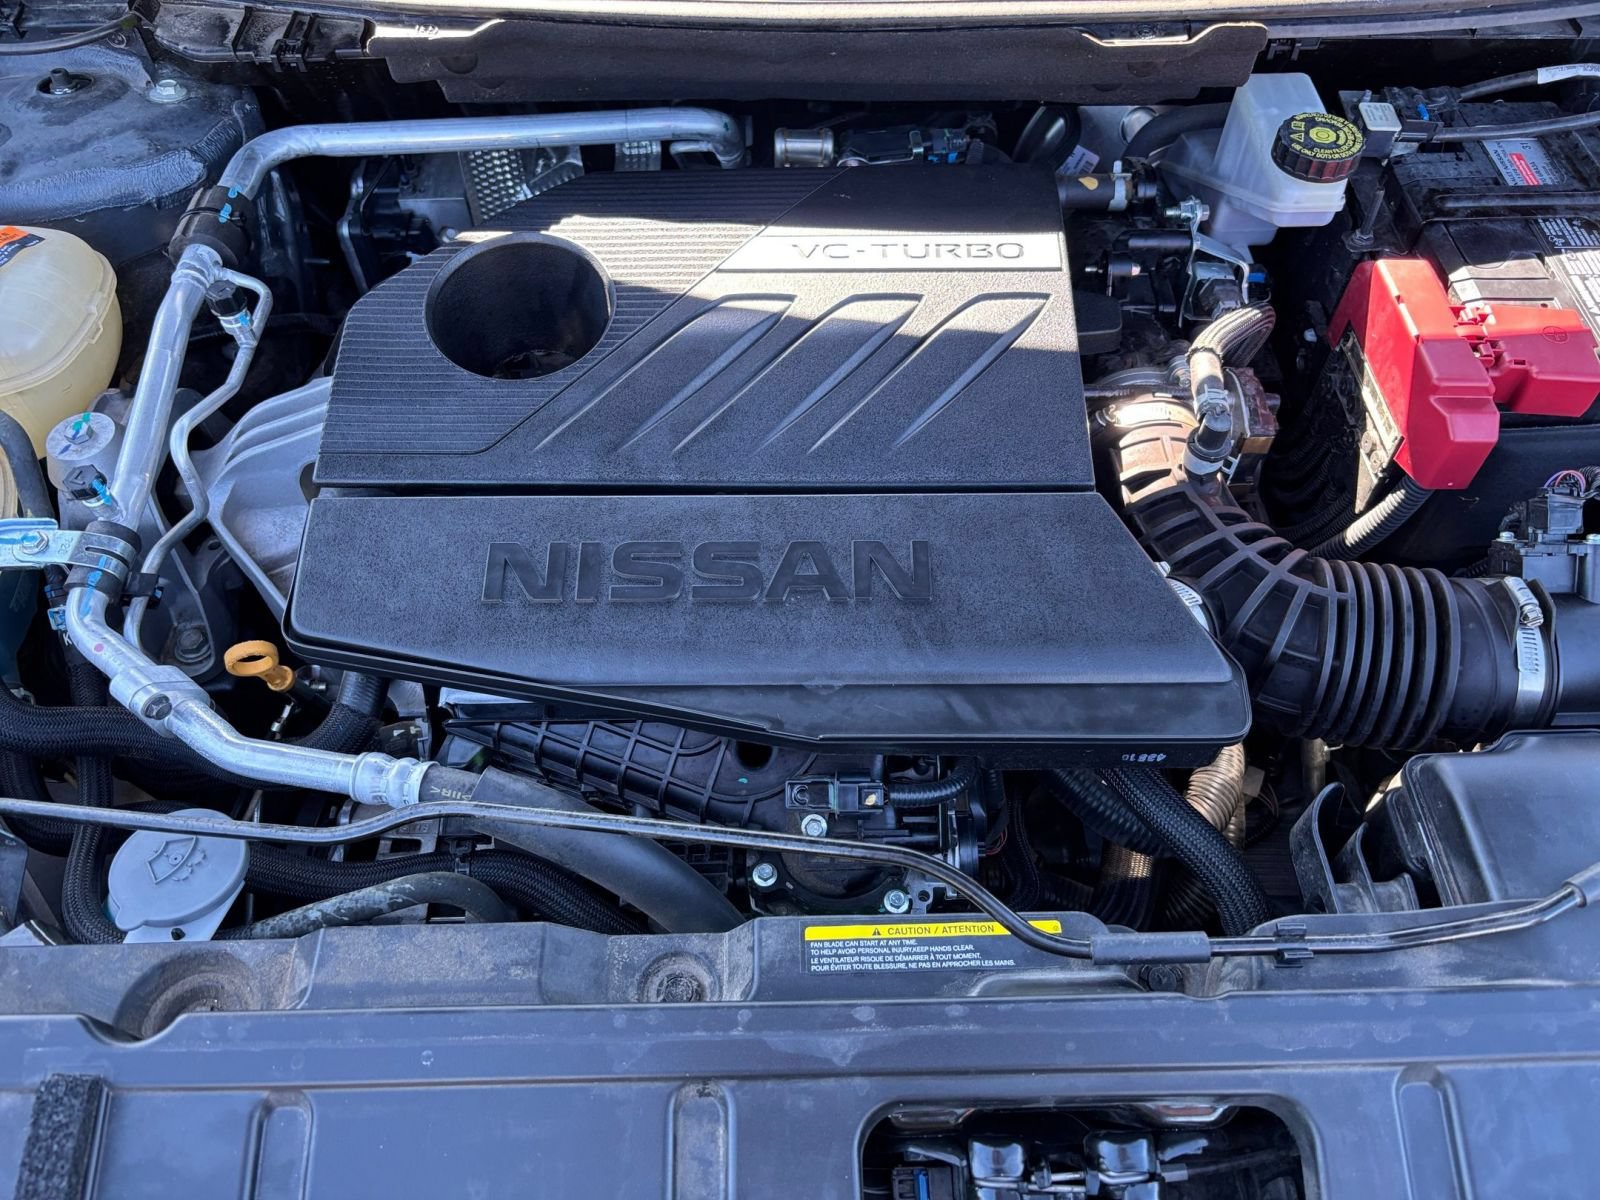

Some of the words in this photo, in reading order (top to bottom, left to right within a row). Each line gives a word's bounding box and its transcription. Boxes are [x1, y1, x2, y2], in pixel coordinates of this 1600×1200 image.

[792, 242, 1024, 258] VC-TURBO
[481, 540, 935, 603] NISSAN
[888, 926, 930, 936] CAUTION
[942, 924, 995, 934] ATTENTION
[830, 963, 852, 971] ÉVITER
